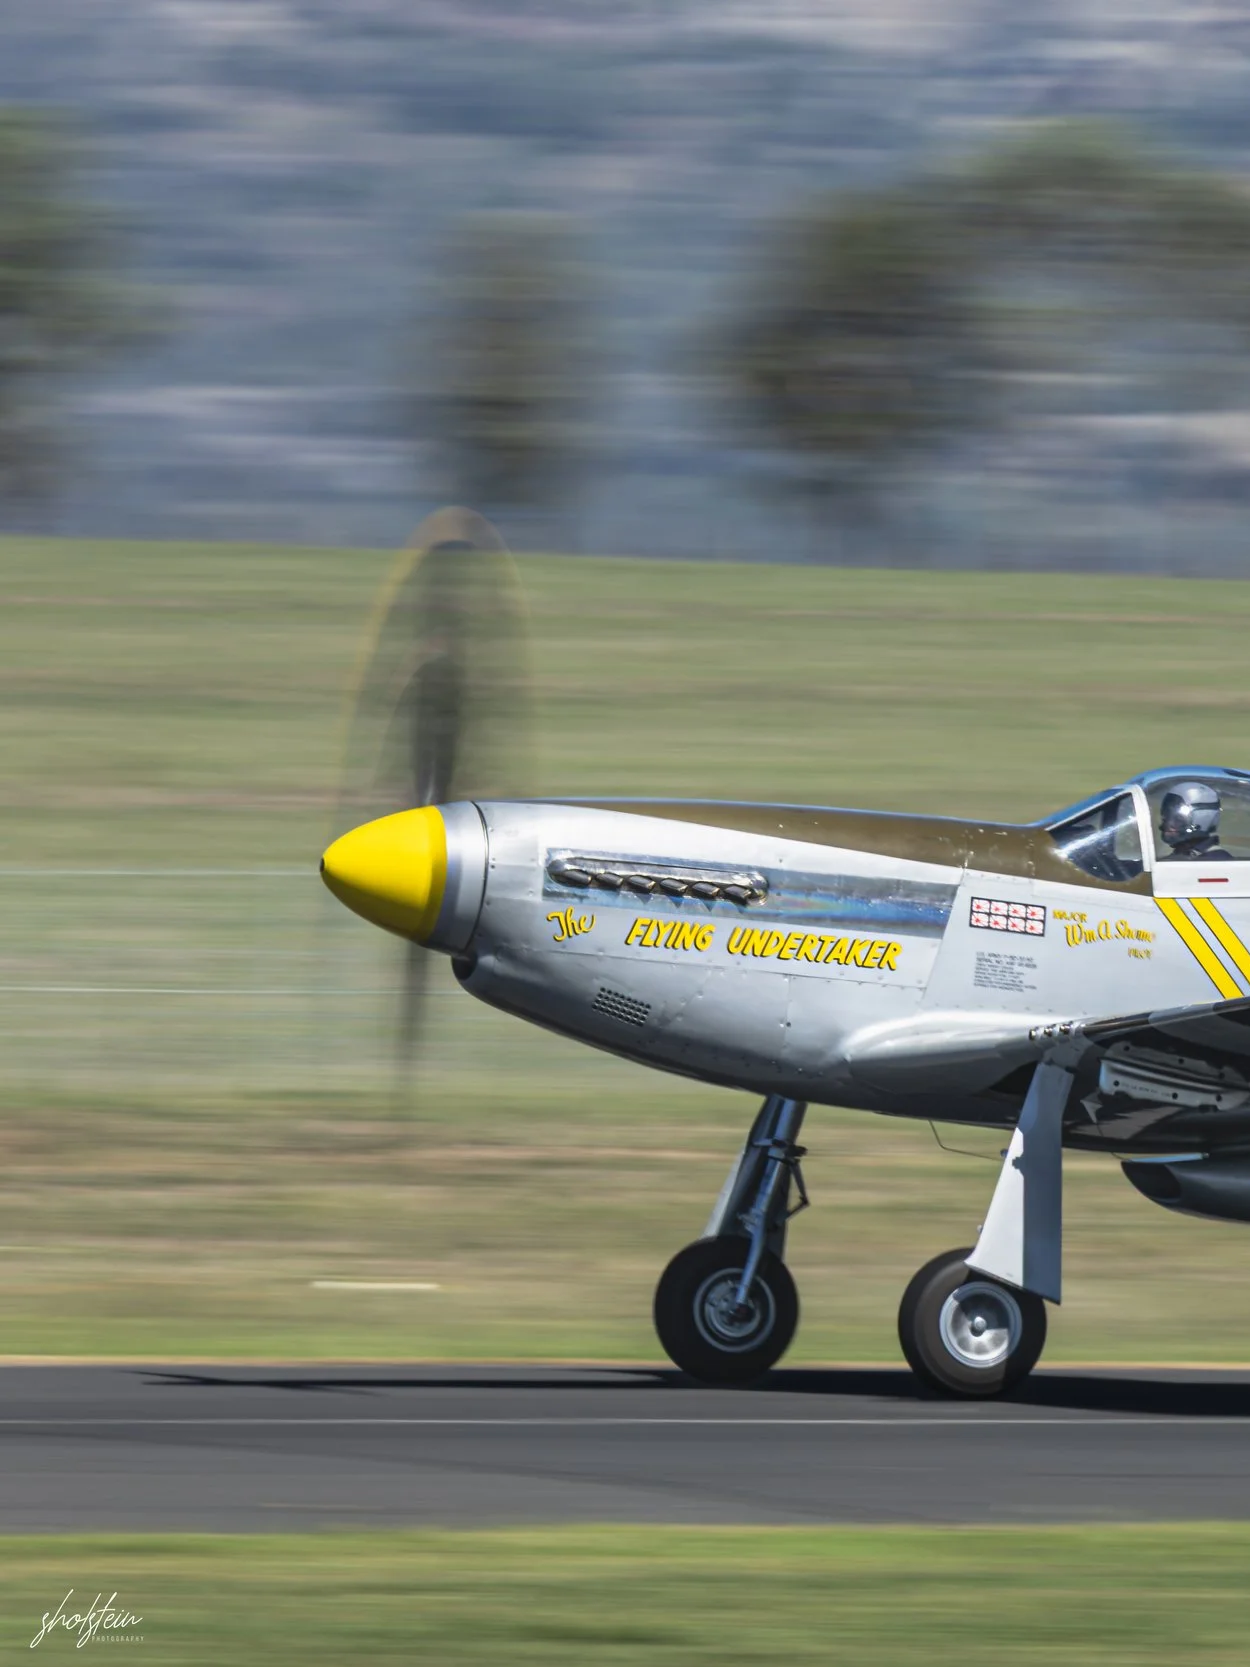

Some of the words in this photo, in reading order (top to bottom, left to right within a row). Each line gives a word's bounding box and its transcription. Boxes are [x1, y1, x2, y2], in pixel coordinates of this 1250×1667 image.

[546, 906, 597, 942] The
[625, 917, 716, 952] FLYING
[727, 927, 904, 972] UNDERTAKER
